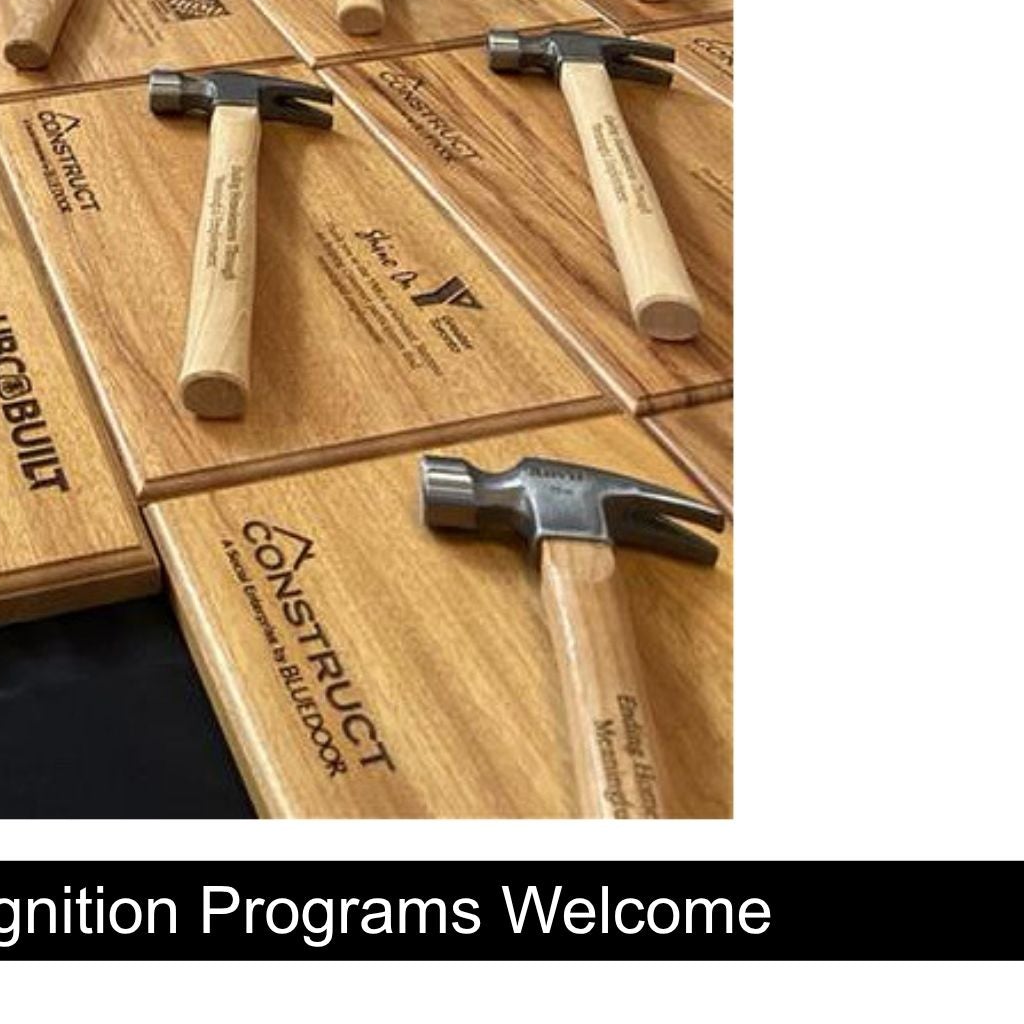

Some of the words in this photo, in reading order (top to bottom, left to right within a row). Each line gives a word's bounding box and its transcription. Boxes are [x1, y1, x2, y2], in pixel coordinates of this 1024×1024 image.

[379, 72, 483, 160] CONSTRUCT
[37, 110, 101, 212] CONSTRUCT
[221, 538, 233, 550] A
[225, 546, 253, 584] Social
[243, 584, 280, 646] Enterprise
[243, 520, 396, 772] CONSTRUCT
[272, 645, 288, 664] by
[616, 694, 644, 757] Ending
